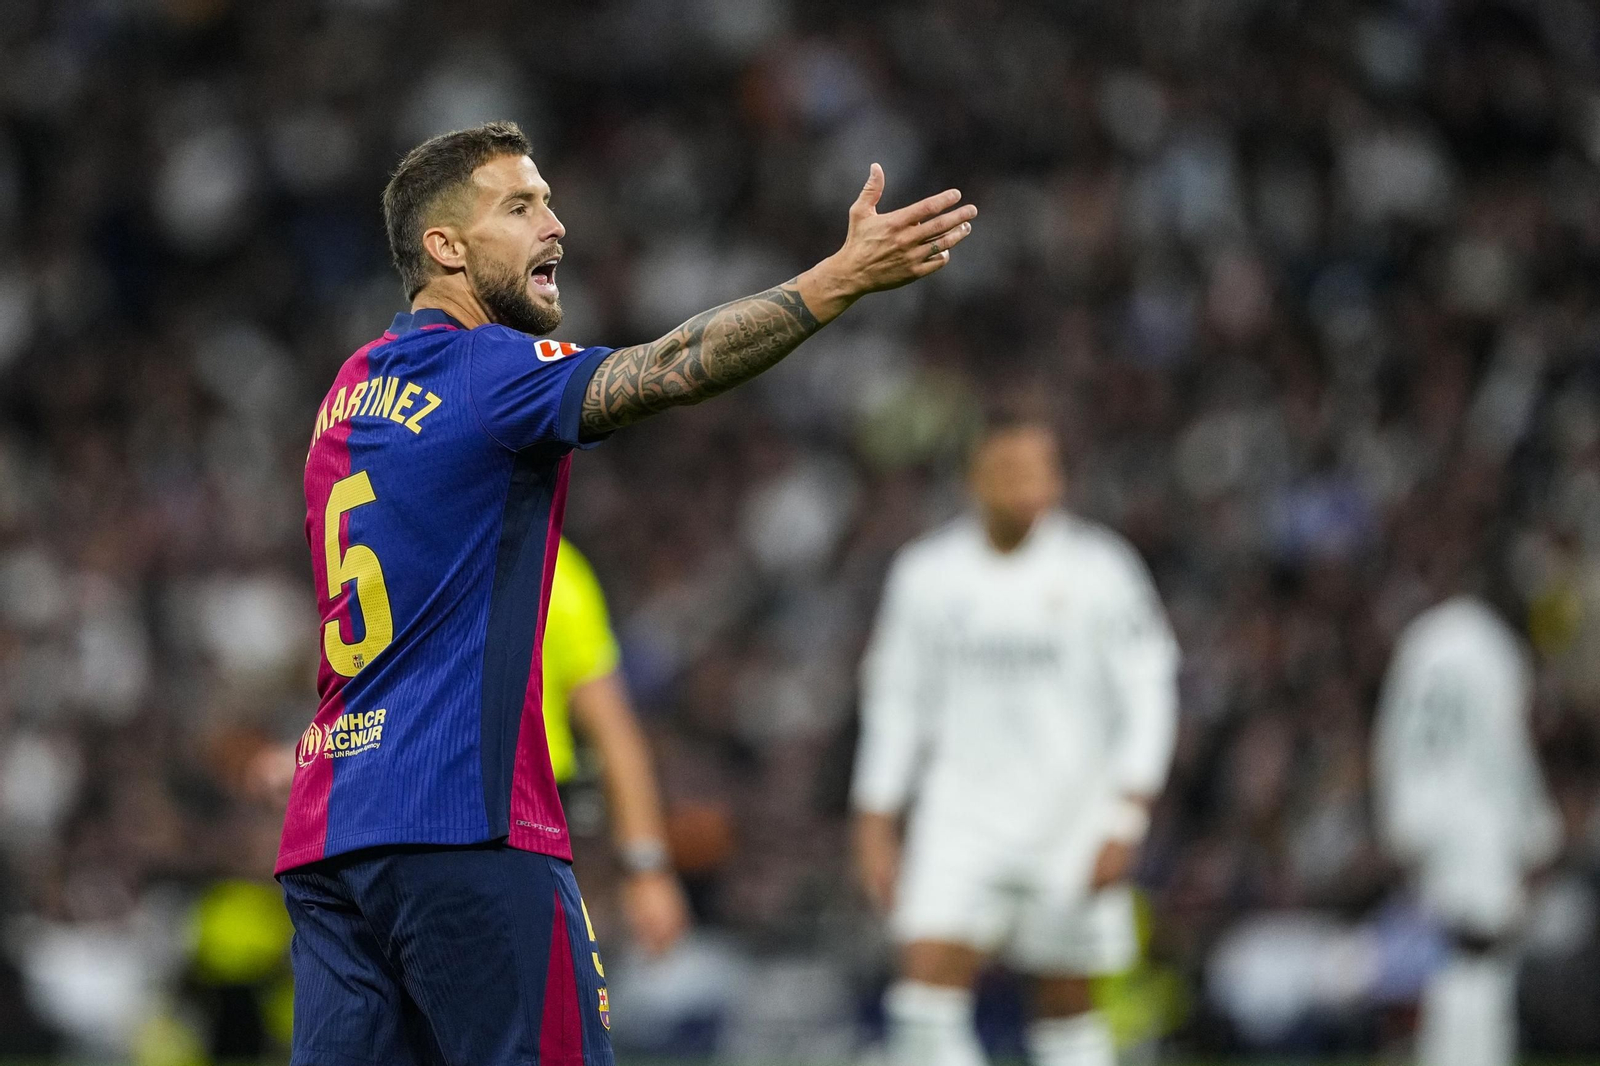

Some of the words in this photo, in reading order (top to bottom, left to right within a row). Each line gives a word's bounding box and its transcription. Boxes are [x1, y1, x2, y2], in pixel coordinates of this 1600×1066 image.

[312, 376, 442, 448] MARTINEZ
[324, 469, 394, 678] 5
[323, 725, 382, 751] ACNUR
[331, 708, 387, 733] NHCR
